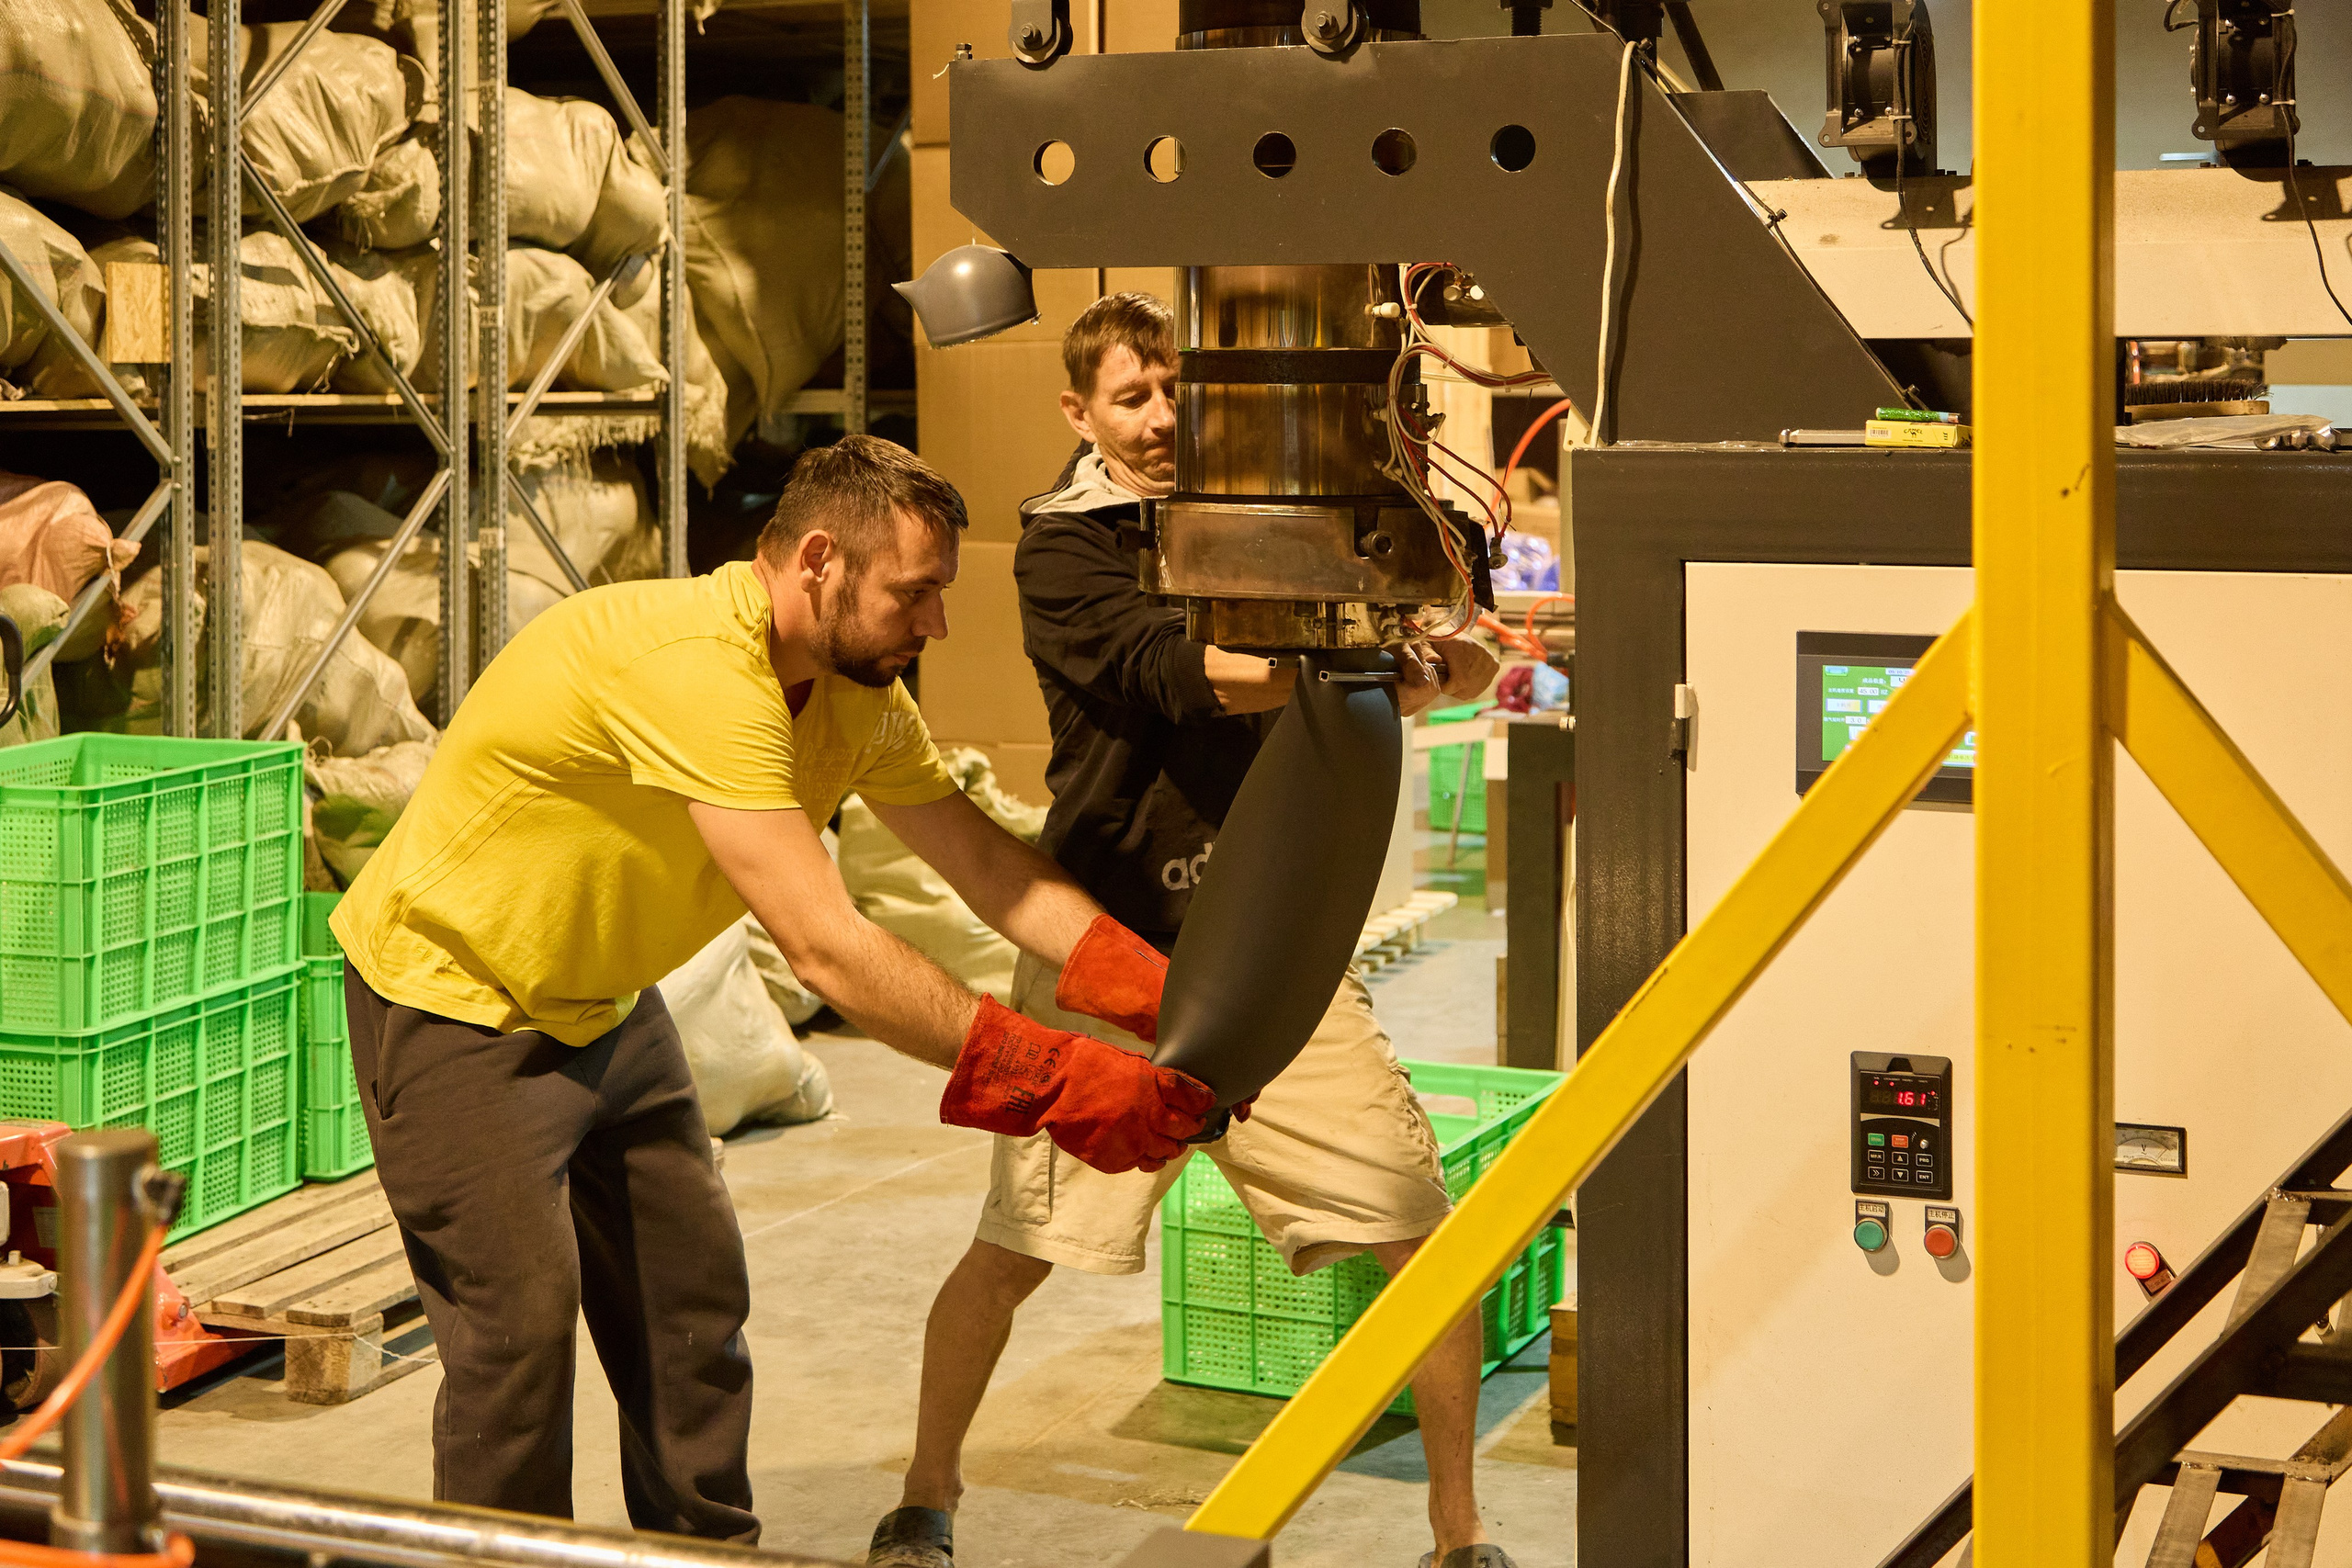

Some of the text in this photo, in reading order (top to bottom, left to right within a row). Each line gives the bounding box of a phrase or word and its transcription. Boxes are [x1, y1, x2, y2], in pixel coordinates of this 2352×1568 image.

[1161, 840, 1216, 891] ad
[1044, 1047, 1060, 1068] CE
[2141, 1144, 2147, 1152] V
[1859, 1203, 1885, 1213] 主机启动
[1928, 1210, 1955, 1220] 主机停止
